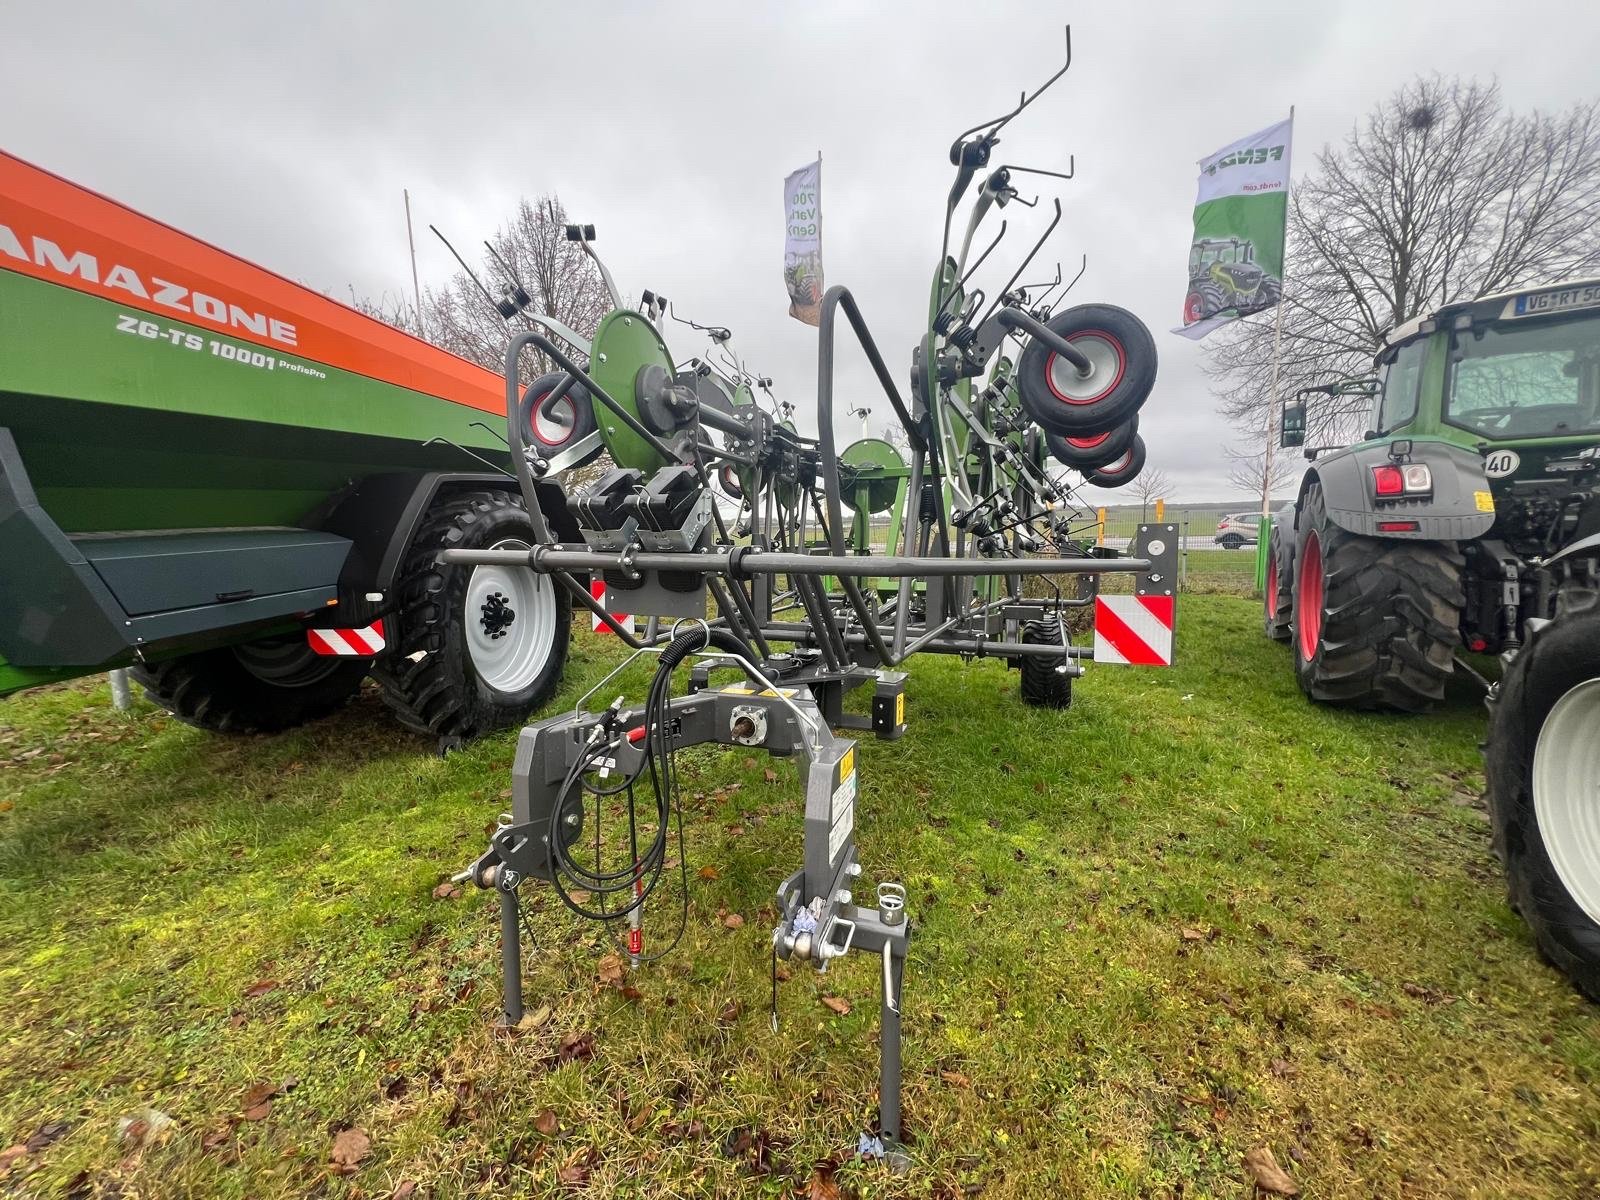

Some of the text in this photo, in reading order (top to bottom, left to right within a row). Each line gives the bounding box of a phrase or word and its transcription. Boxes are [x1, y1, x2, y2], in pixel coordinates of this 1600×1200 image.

[1529, 295, 1548, 310] VG
[1560, 291, 1579, 306] RT
[116, 315, 326, 379] ZG-TS 10001 ProfisPro
[1488, 456, 1512, 473] 40
